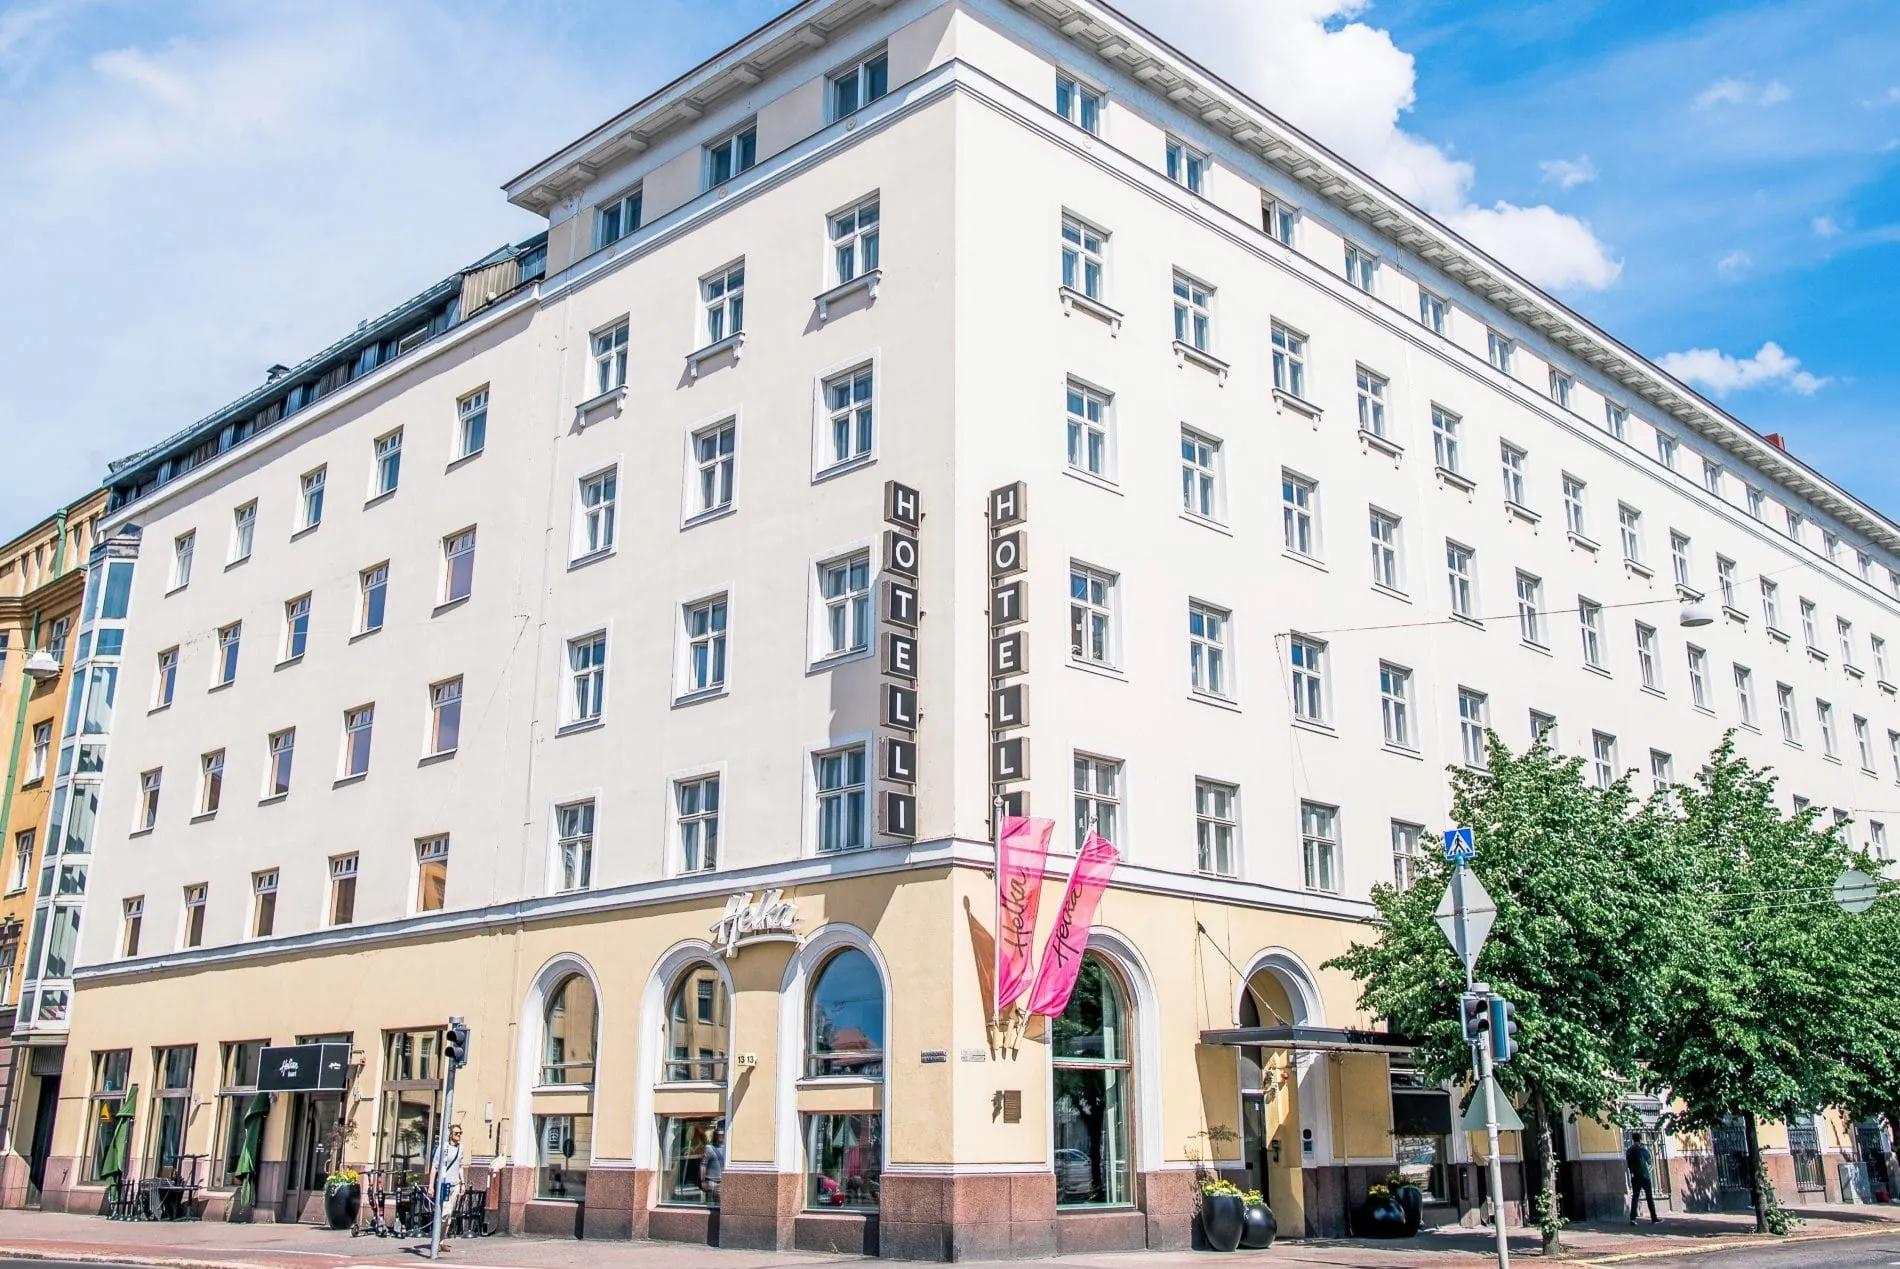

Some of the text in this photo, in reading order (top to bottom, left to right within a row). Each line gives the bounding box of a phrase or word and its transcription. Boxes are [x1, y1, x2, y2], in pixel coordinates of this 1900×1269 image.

[895, 489, 915, 829] HOTELLI
[995, 489, 1016, 828] HOTELLI
[709, 888, 799, 958] Helka
[1001, 868, 1033, 957] Helka
[737, 1055, 754, 1064] 13 13
